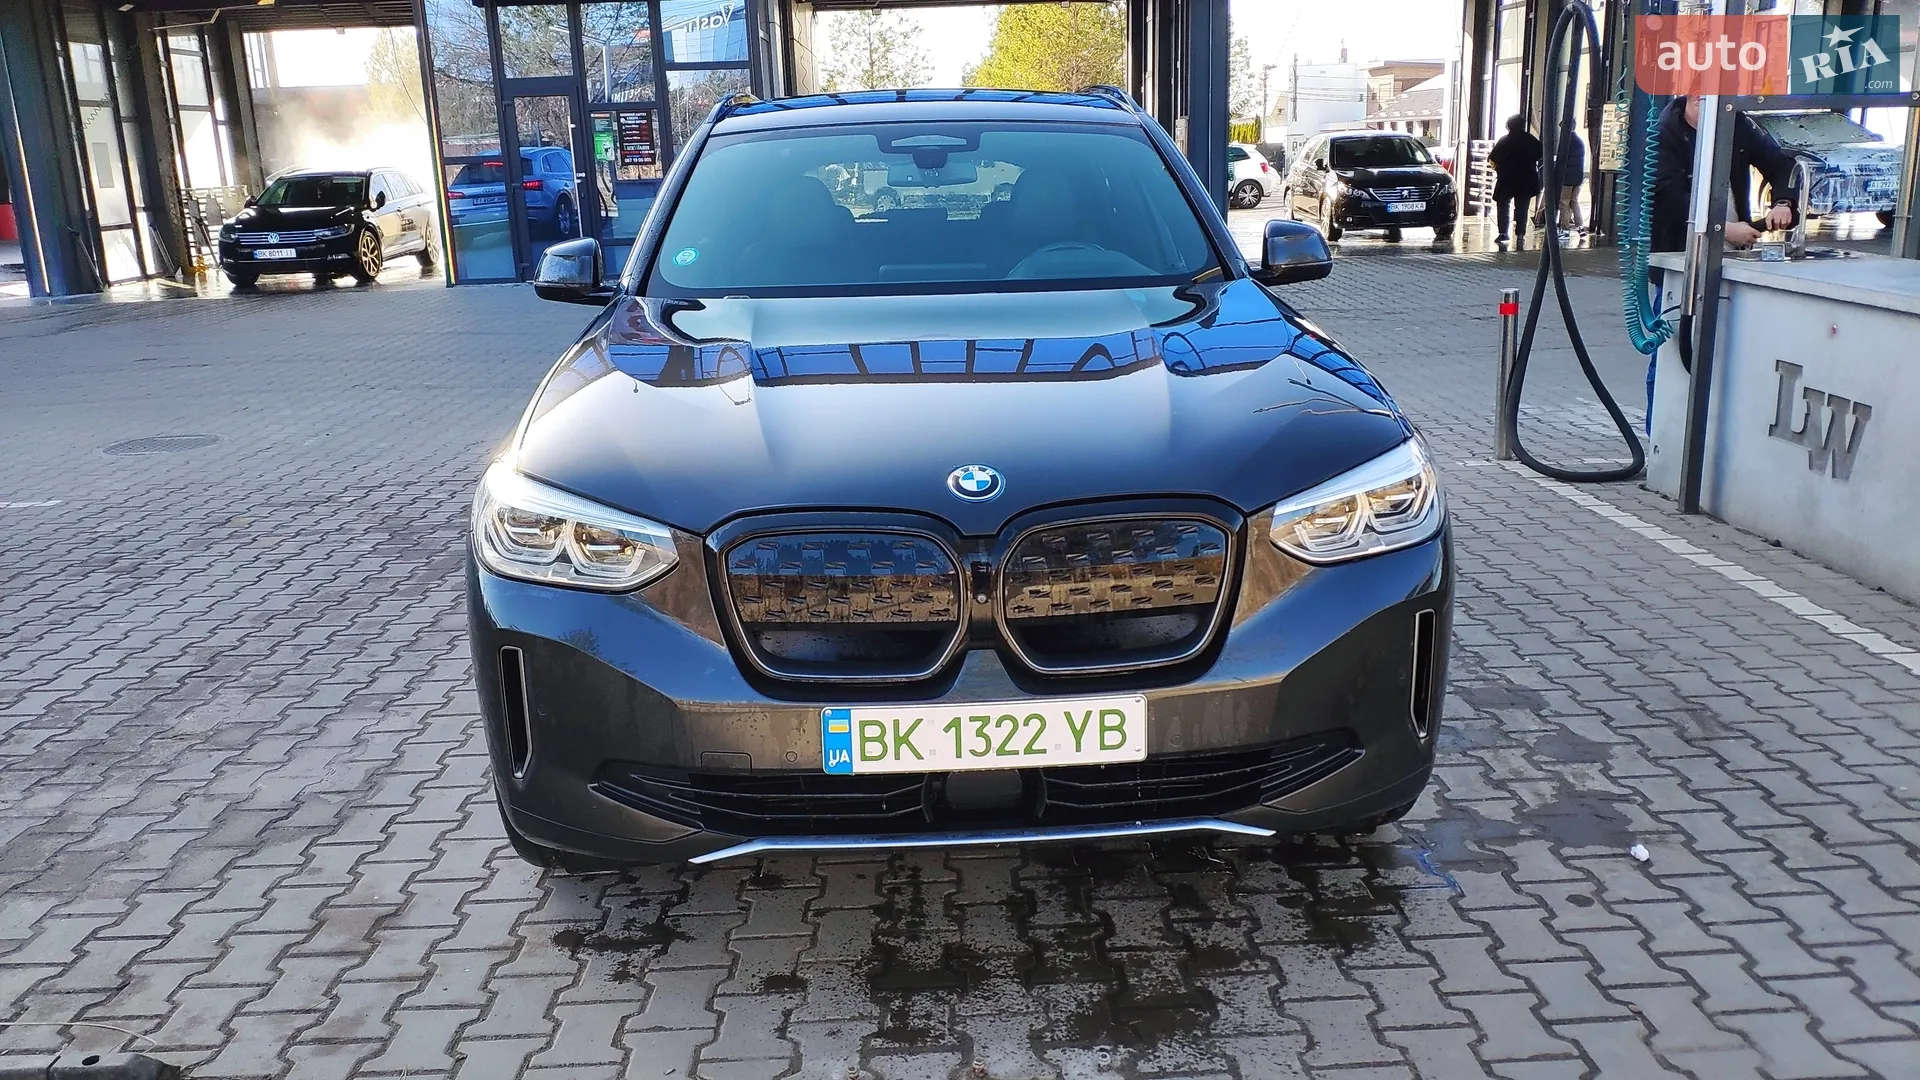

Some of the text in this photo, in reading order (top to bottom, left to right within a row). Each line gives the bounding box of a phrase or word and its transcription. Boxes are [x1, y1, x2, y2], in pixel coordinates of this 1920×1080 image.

[954, 466, 995, 476] BMW
[858, 708, 1127, 762] BK 1322 YB
[829, 749, 851, 763] UA
